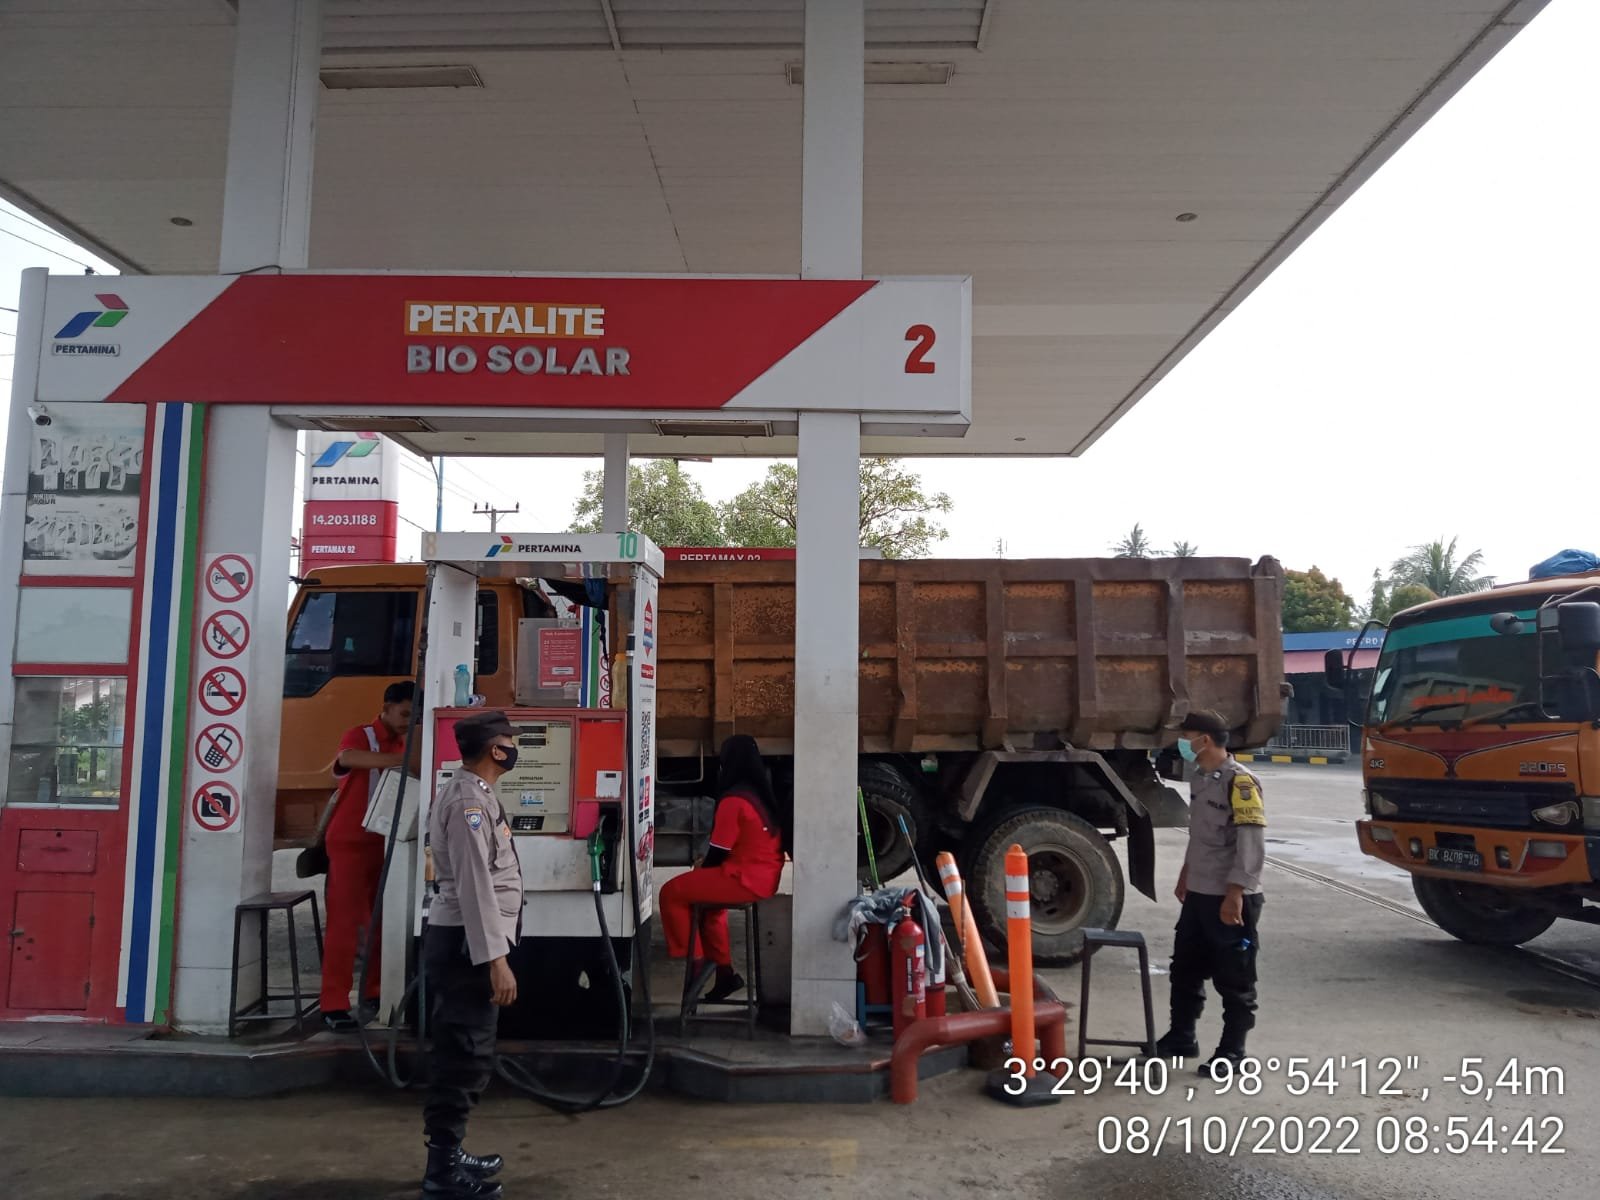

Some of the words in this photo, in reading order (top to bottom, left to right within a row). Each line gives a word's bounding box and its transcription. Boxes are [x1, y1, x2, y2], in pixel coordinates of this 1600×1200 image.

[408, 304, 605, 336] PERTALITE
[55, 344, 116, 354] PERTAMINA
[904, 324, 936, 374] 2
[406, 344, 478, 374] BIO
[485, 344, 631, 376] SOLAR
[312, 476, 380, 485] PERTAMINA
[312, 514, 377, 526] 14.203.1188
[311, 545, 346, 554] PERTAMAX
[347, 545, 356, 554] 92
[517, 544, 582, 553] PERTAMINA
[615, 531, 639, 560] 10
